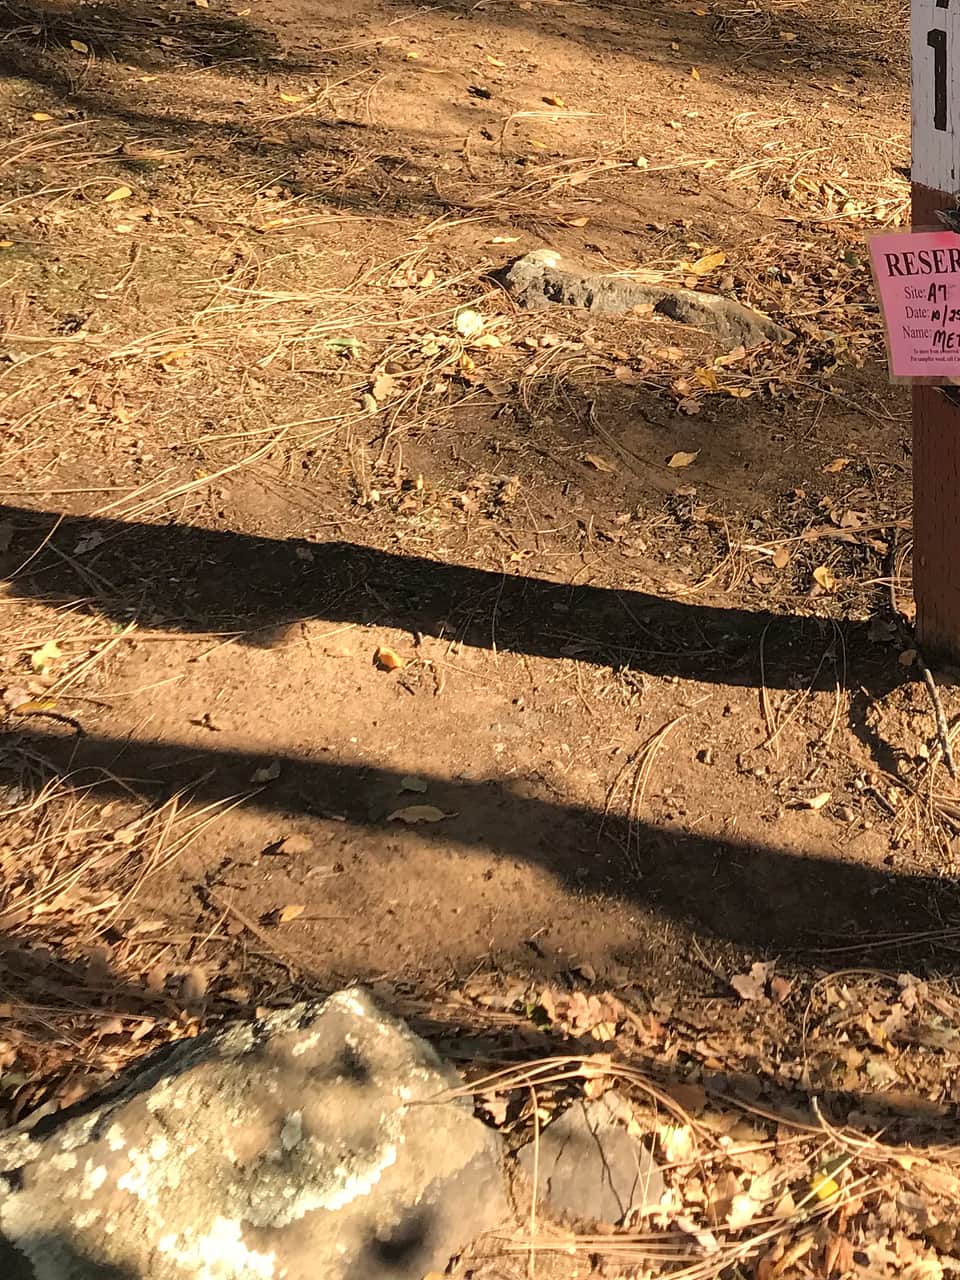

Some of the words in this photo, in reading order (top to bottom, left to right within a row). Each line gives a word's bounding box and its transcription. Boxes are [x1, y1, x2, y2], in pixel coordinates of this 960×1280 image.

[904, 286, 927, 300] Site:
[928, 282, 947, 304] A7
[905, 306, 930, 319] Date:
[902, 325, 932, 339] Name:
